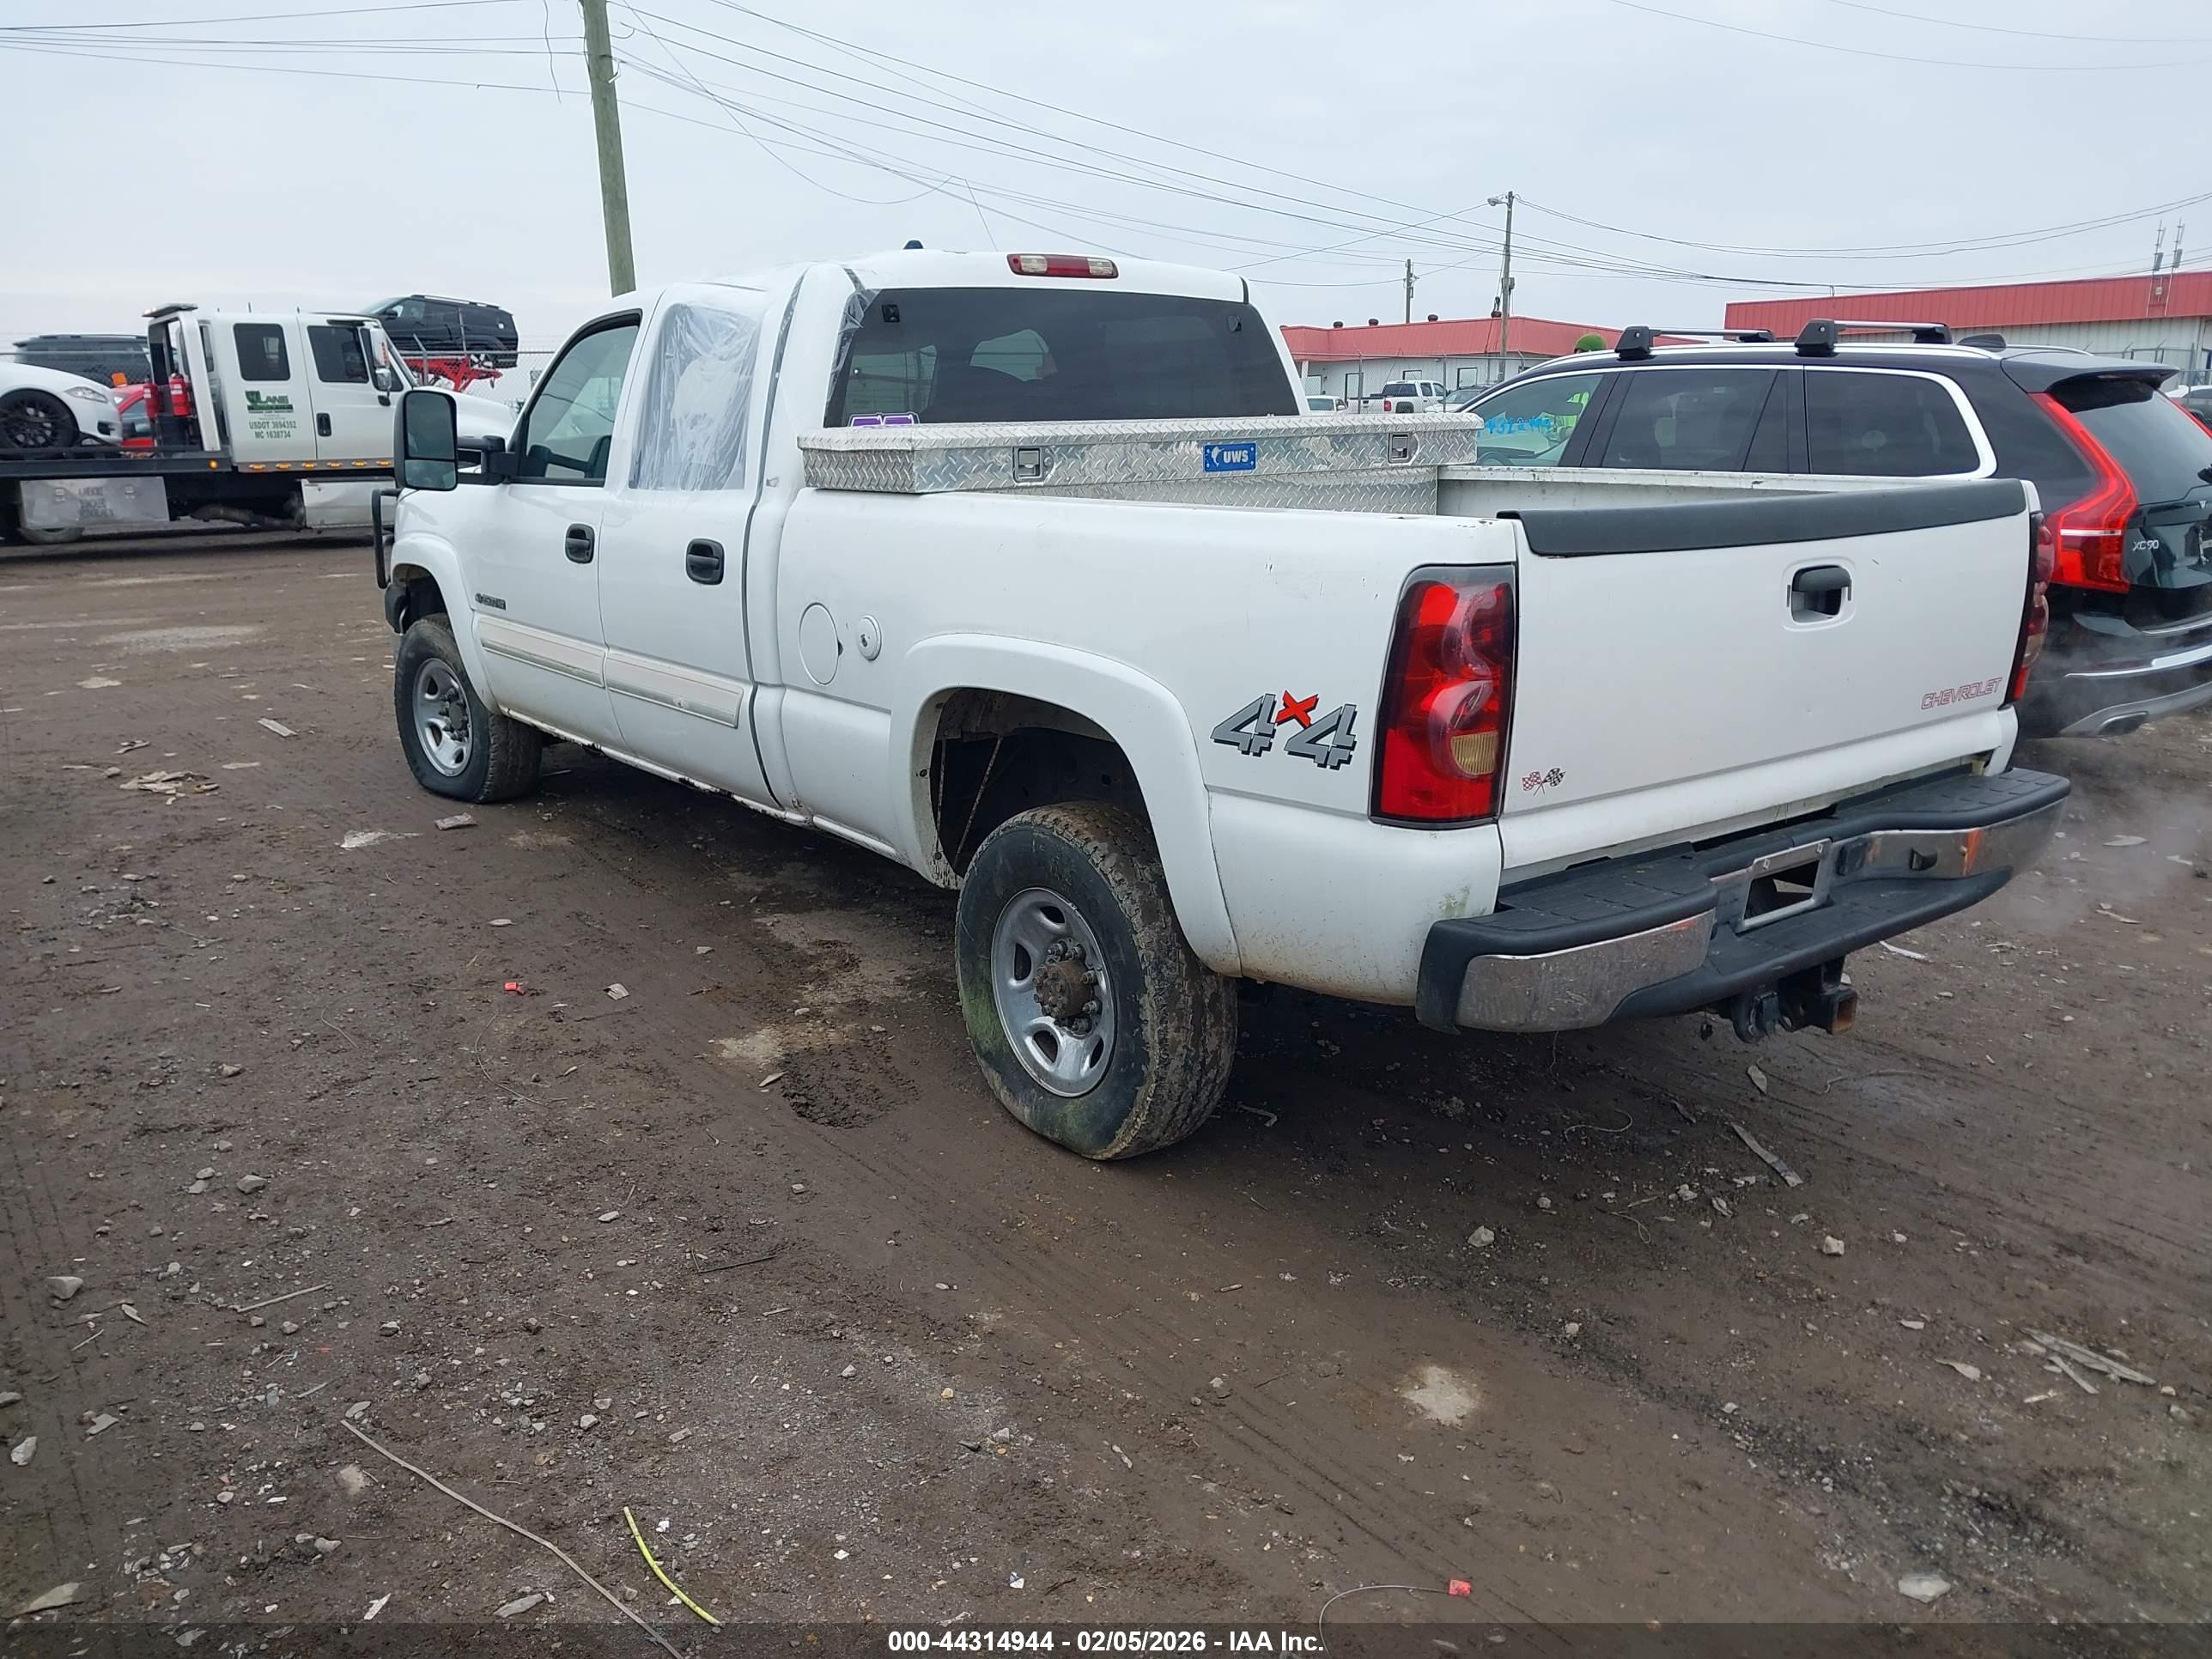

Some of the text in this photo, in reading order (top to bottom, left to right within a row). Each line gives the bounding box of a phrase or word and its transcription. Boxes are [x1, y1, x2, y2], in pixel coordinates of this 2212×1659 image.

[1223, 450, 1249, 464] UWS
[2132, 539, 2160, 551] XC90
[1921, 677, 2002, 710] CHEVROLET
